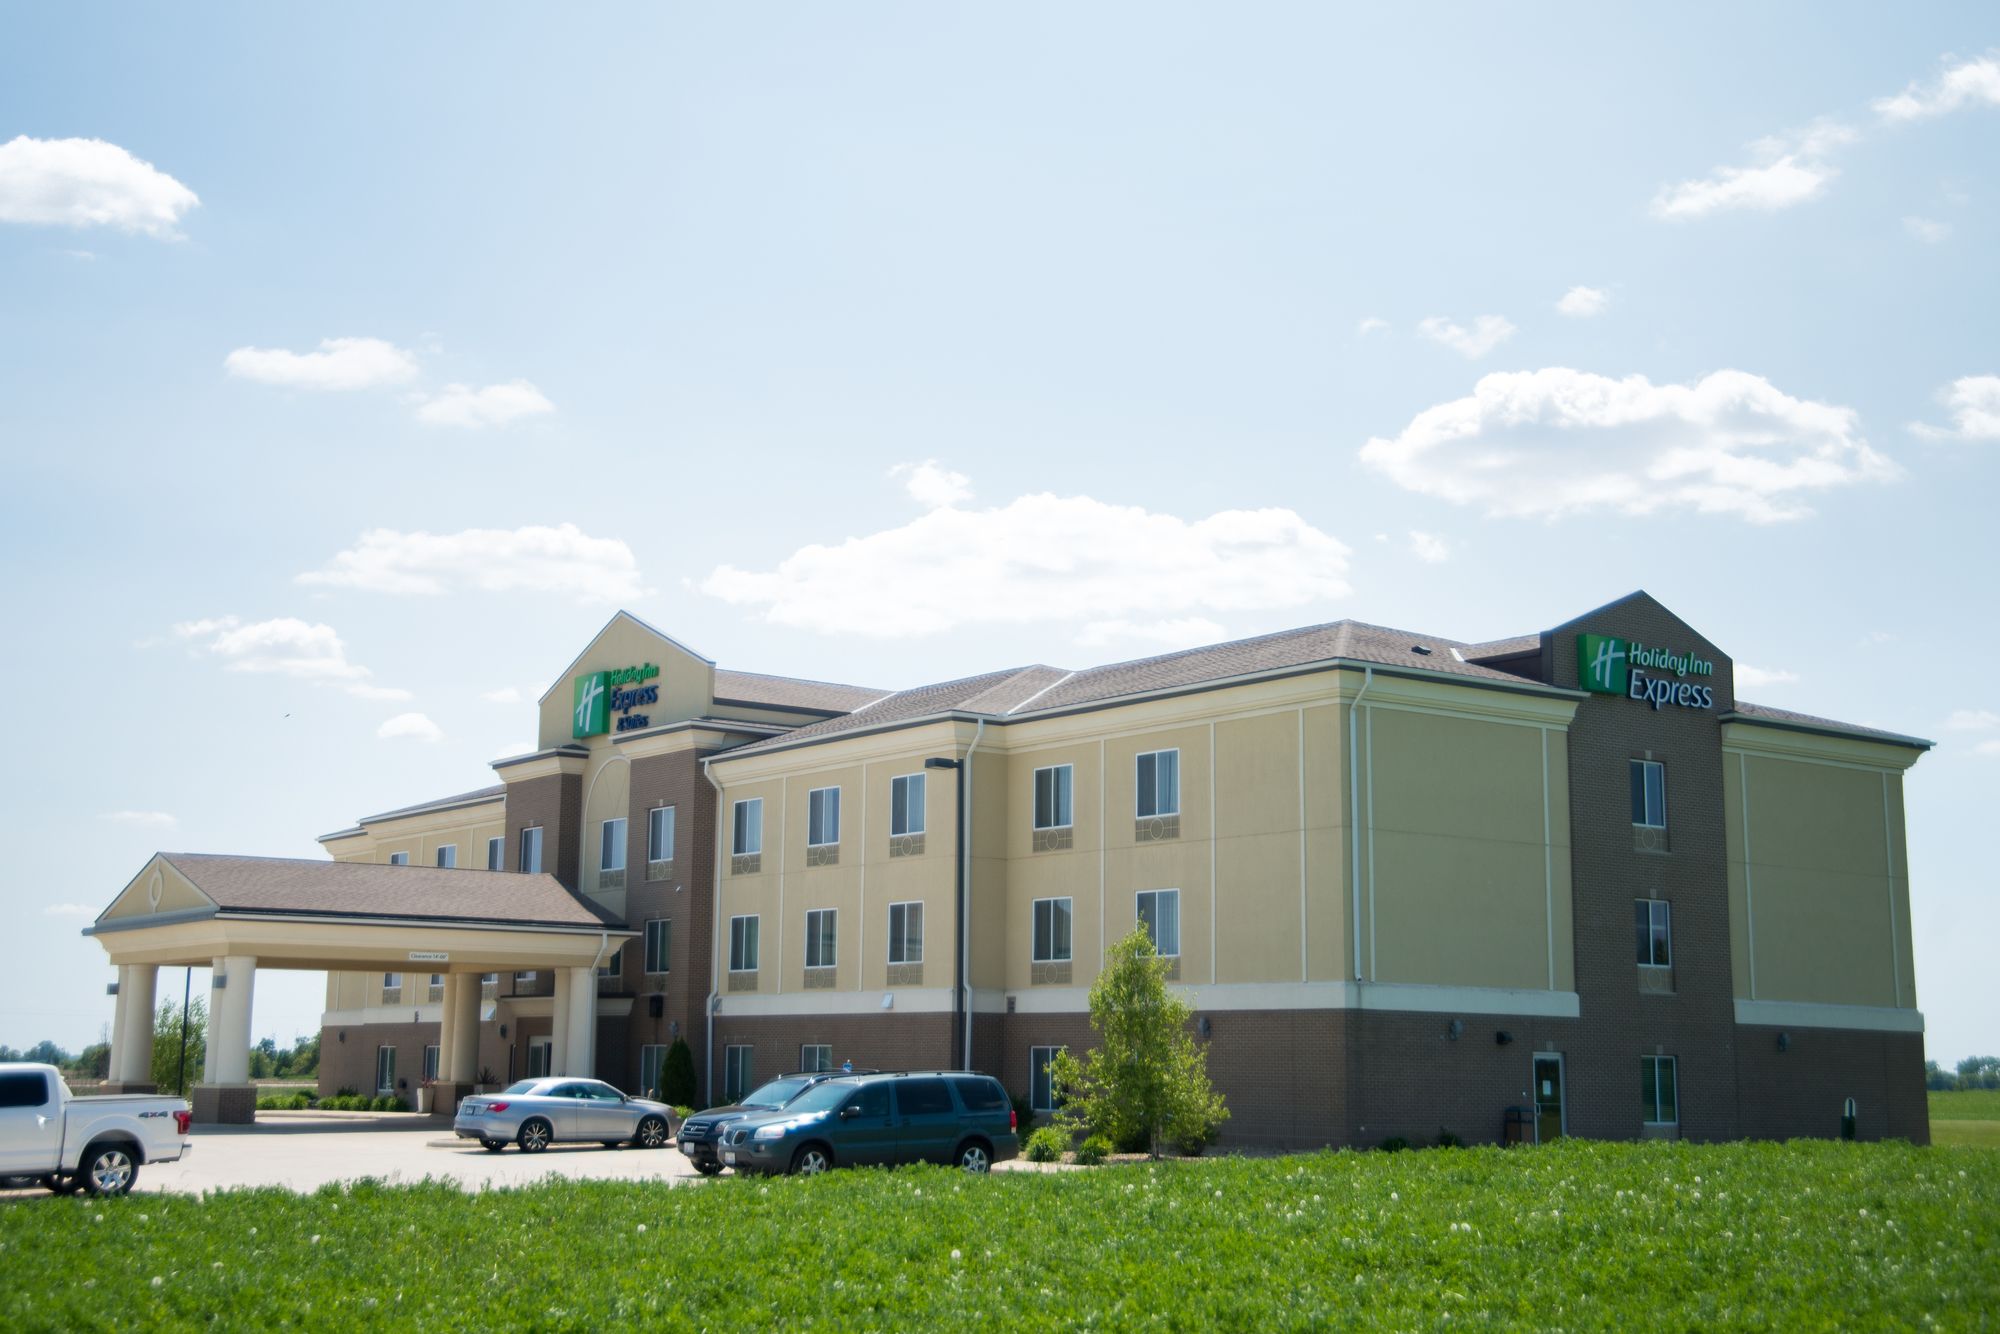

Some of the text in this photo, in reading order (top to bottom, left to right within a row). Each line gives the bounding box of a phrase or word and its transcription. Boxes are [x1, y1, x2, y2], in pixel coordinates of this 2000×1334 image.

[611, 662, 659, 686] Holiday Inn
[1628, 642, 1713, 677] Holiday Inn
[610, 685, 659, 714] Express
[1628, 668, 1713, 711] Express
